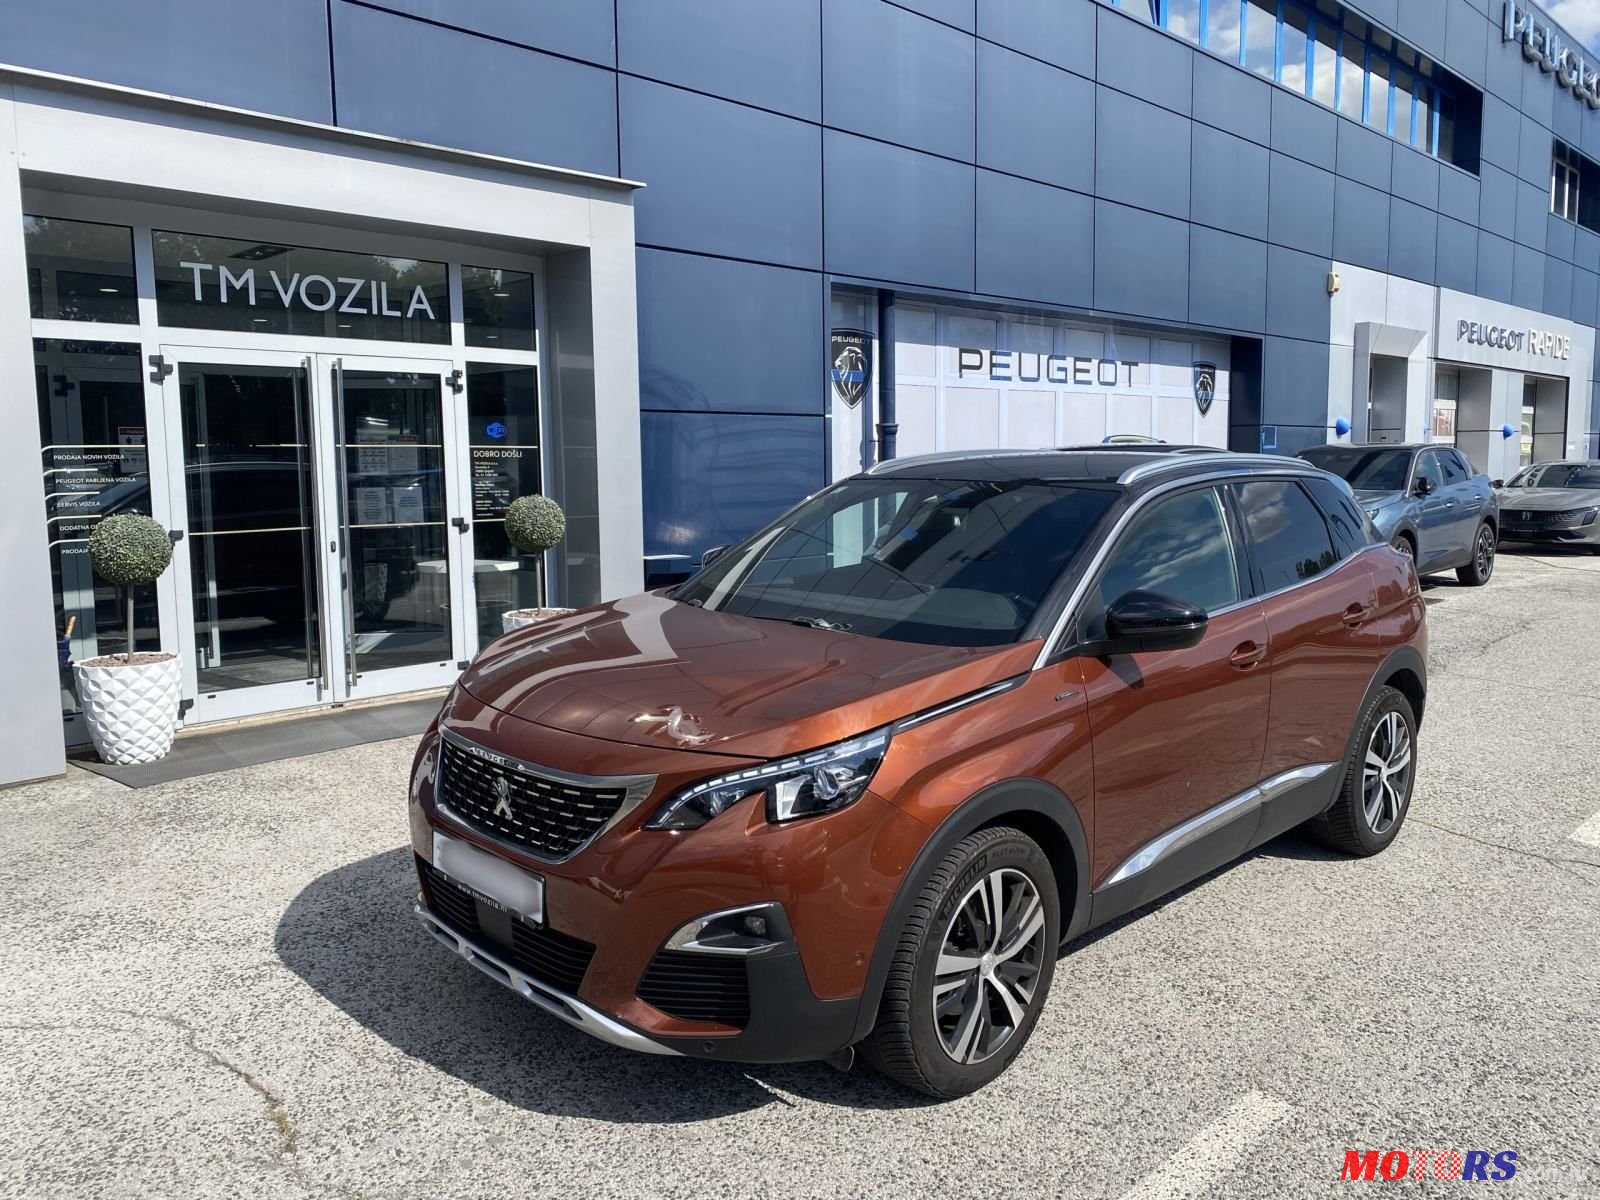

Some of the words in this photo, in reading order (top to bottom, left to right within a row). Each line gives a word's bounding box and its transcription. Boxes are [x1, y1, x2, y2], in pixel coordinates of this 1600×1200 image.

[180, 261, 256, 305] TM
[269, 270, 435, 320] VOZILA
[831, 335, 871, 344] PEUGEOT
[1456, 319, 1525, 352] PEUGEOT
[1527, 328, 1571, 361] RAPIDE
[958, 347, 1139, 388] PEUGEOT
[473, 450, 500, 458] DOBRO
[501, 449, 522, 458] DOŠLI
[457, 883, 508, 913] www.tmvozila.hr
[943, 853, 987, 920] MICHELIN
